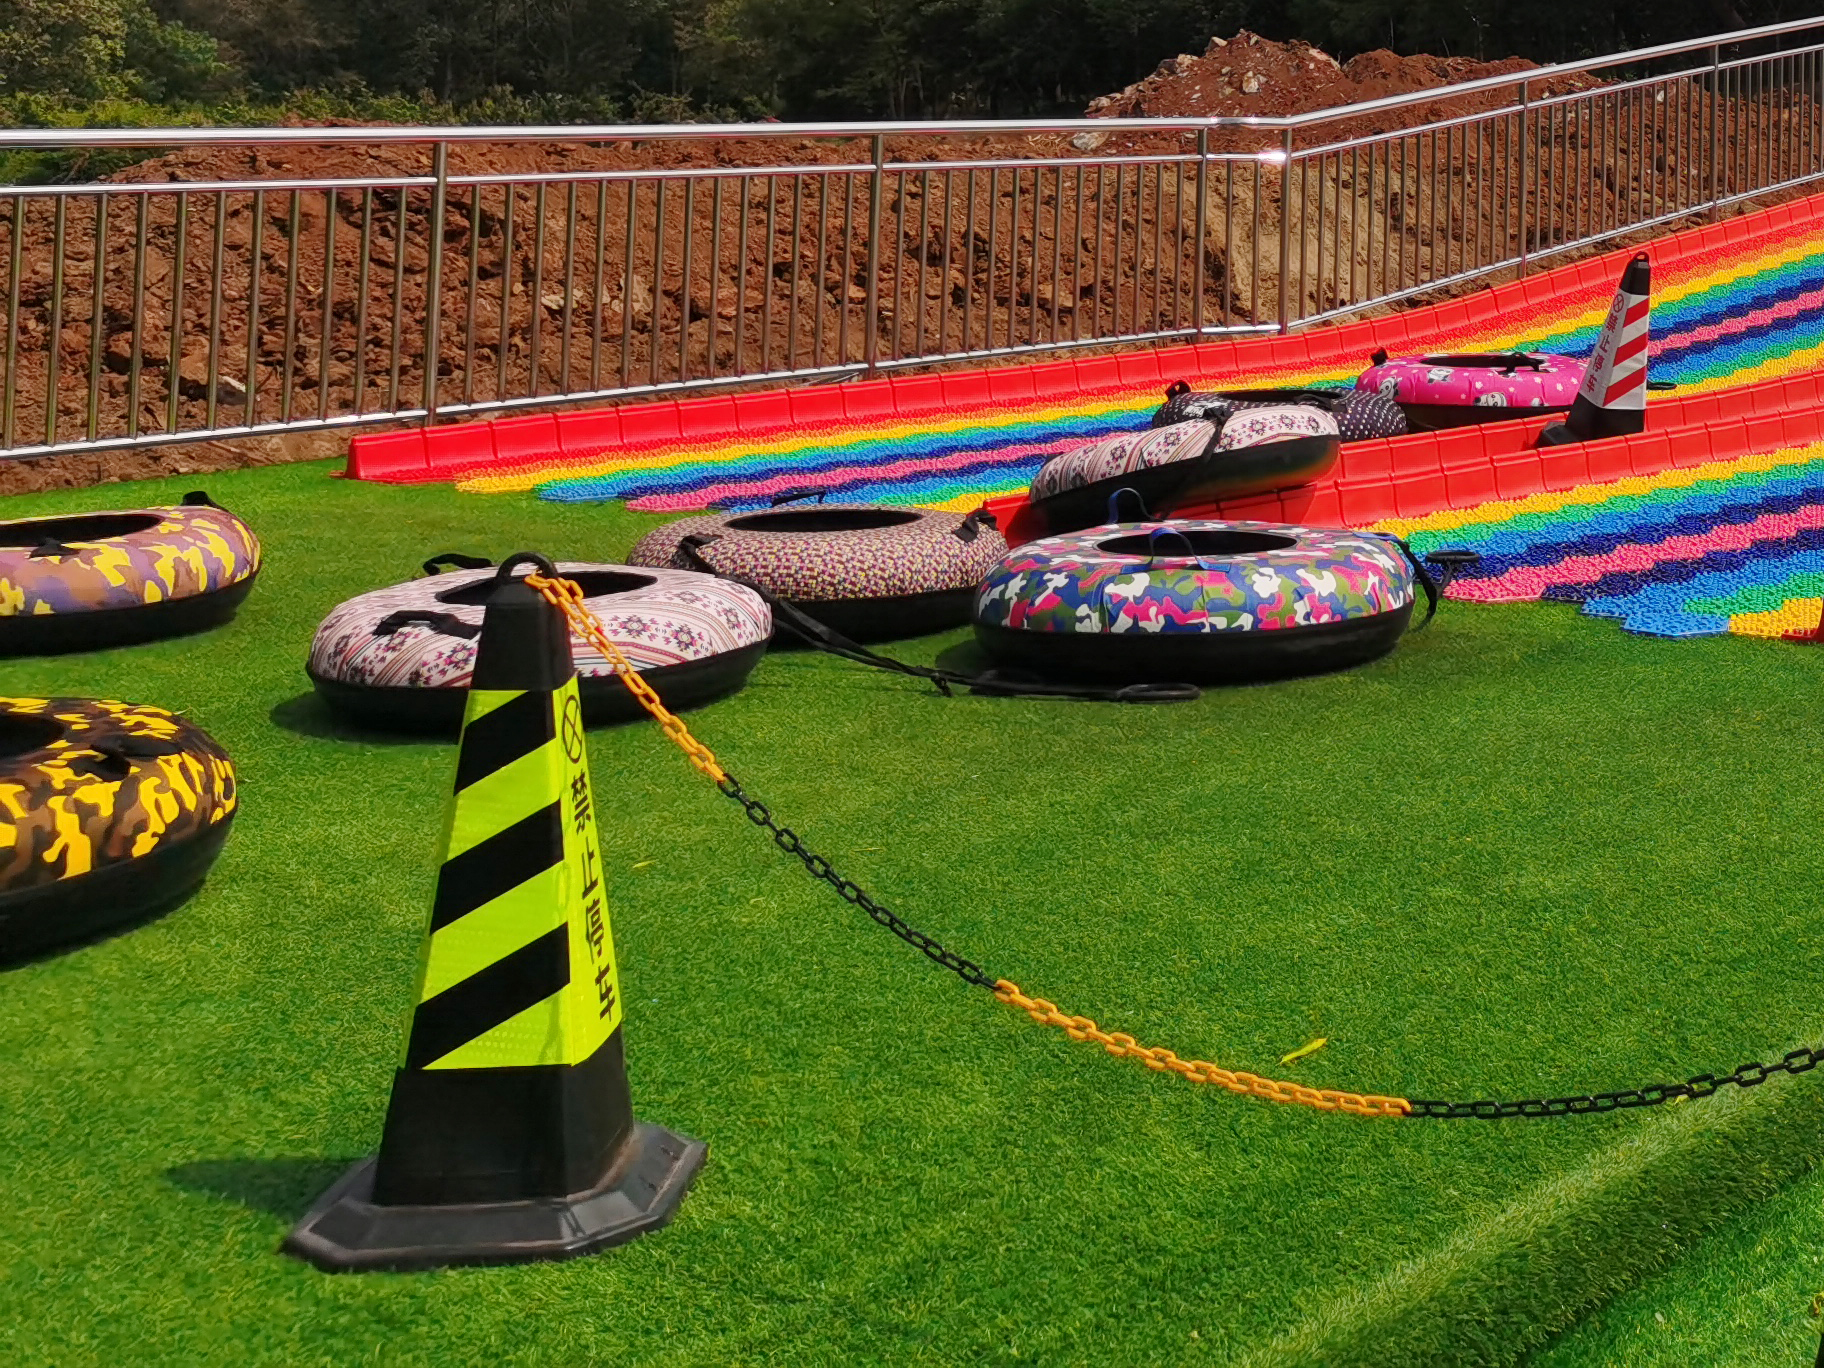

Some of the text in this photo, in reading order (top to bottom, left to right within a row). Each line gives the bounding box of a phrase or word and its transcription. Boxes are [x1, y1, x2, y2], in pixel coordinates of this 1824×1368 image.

[1586, 312, 1619, 393] 禁止停车
[571, 768, 616, 1023] 禁止停车
